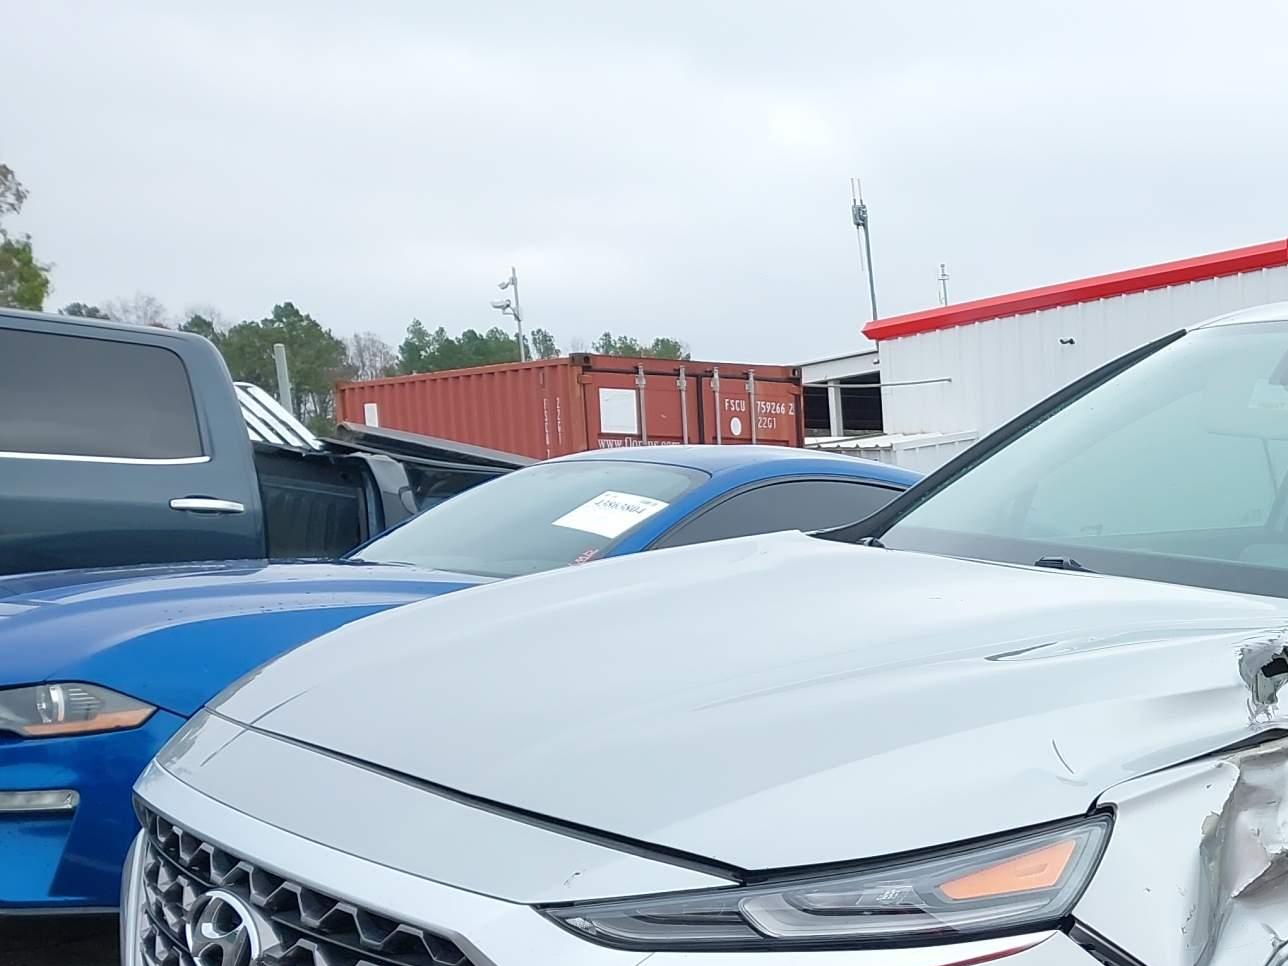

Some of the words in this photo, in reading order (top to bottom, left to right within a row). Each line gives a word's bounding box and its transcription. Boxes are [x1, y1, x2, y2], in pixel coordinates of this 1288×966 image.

[724, 398, 746, 412] FSCU
[756, 400, 786, 414] 759266
[757, 416, 777, 429] 22G1
